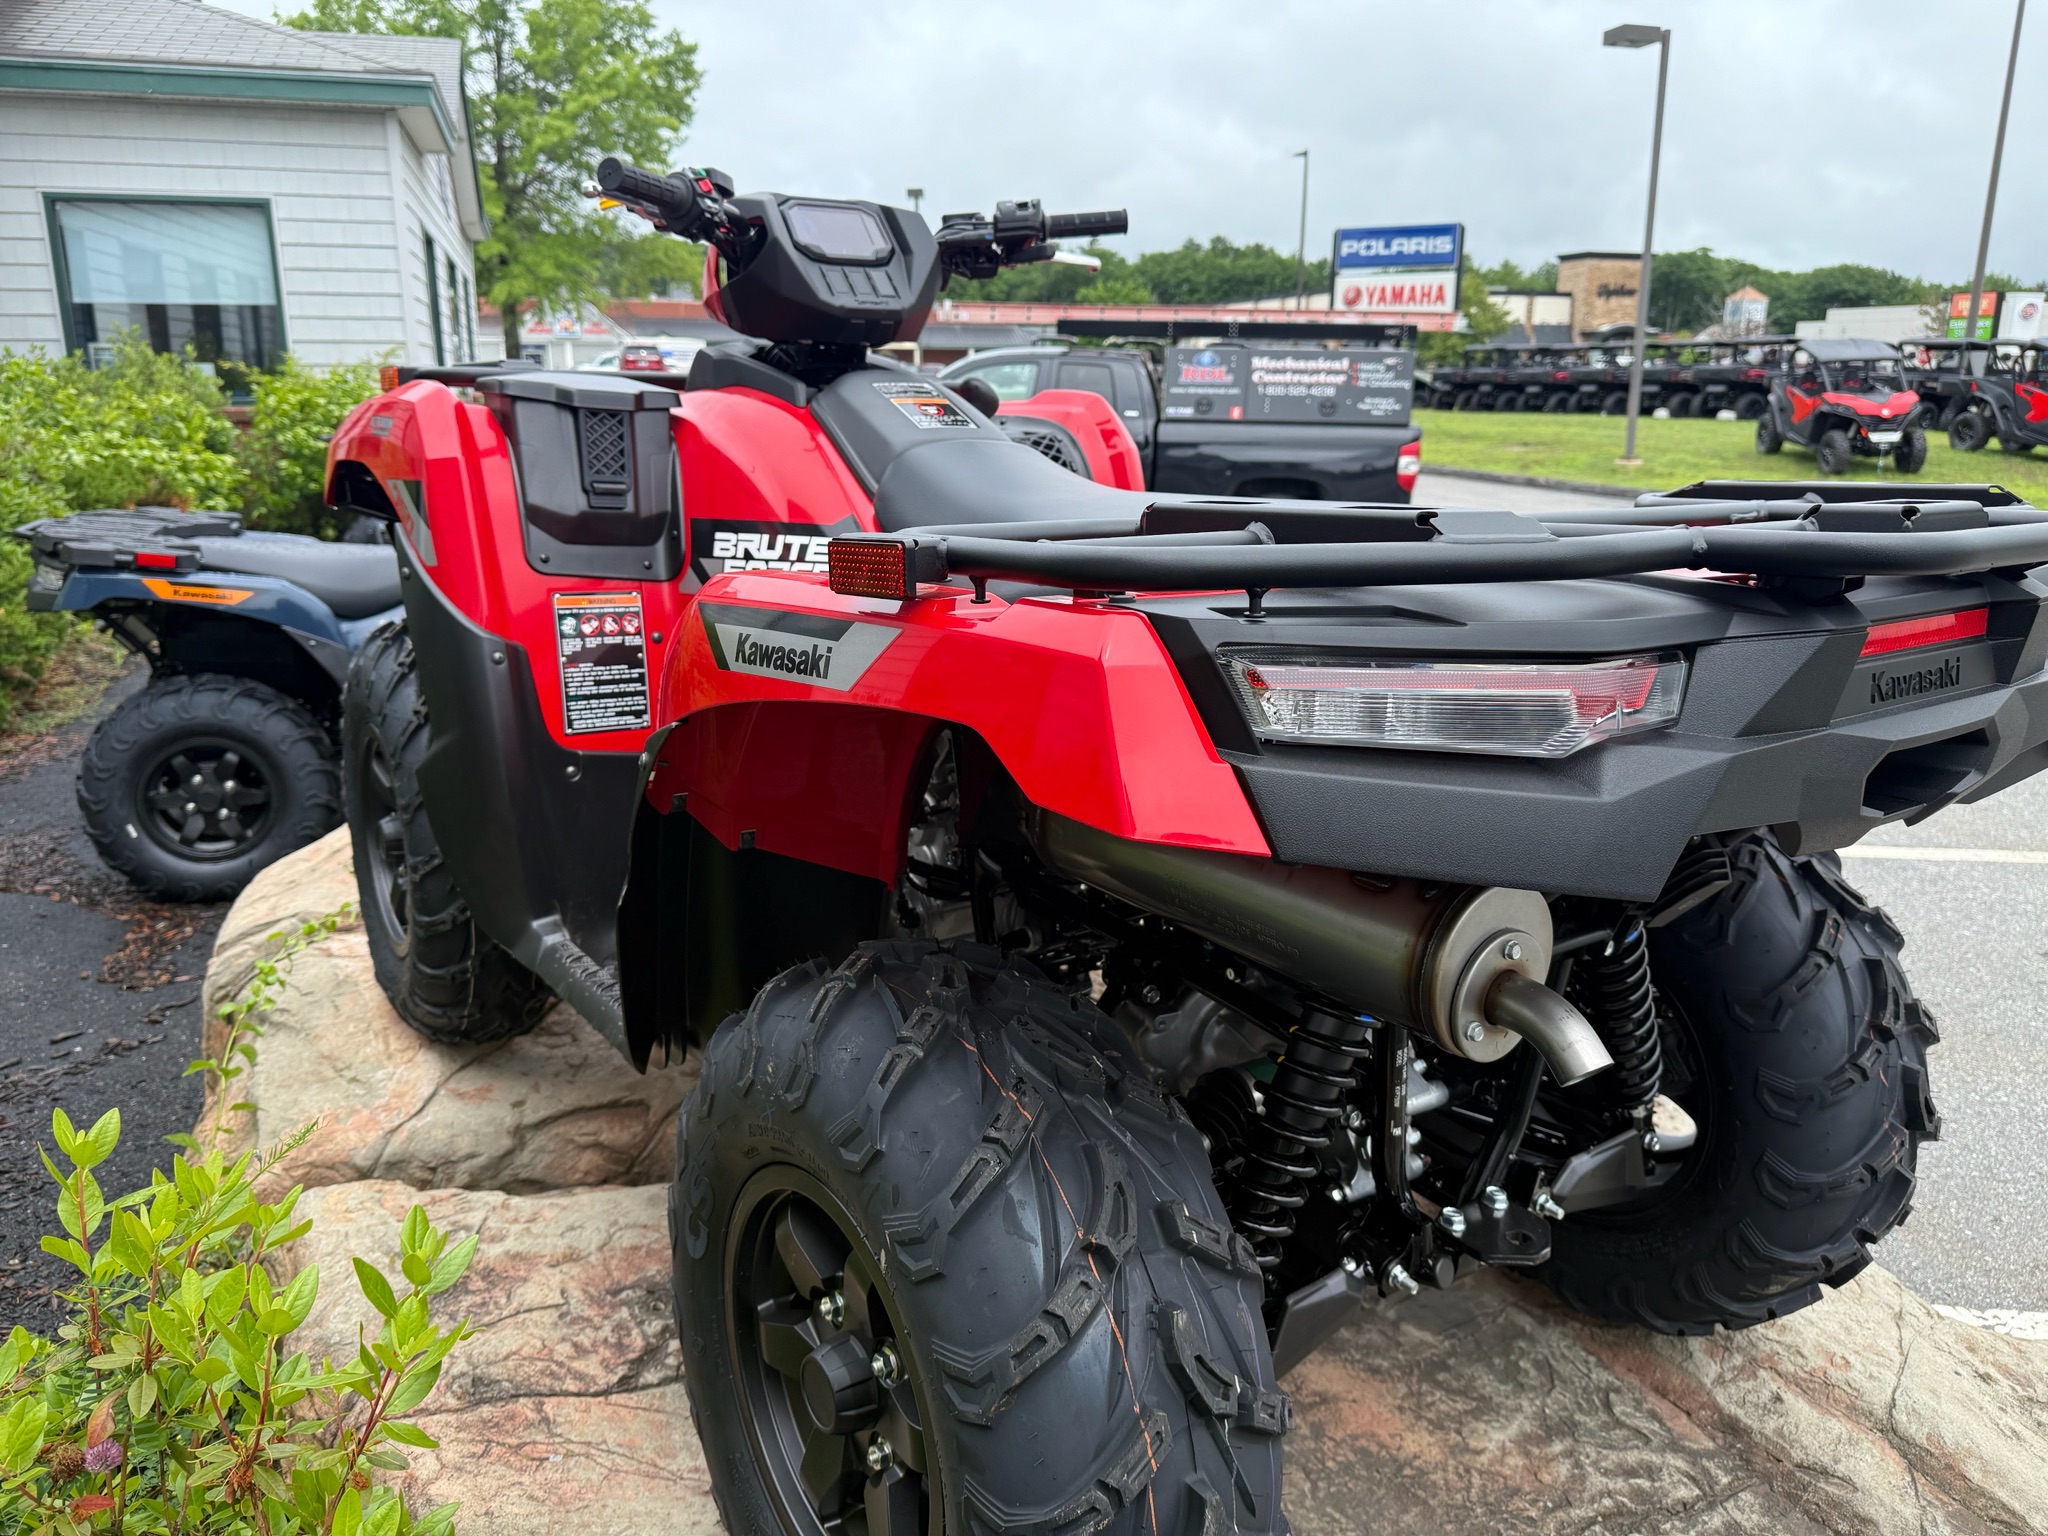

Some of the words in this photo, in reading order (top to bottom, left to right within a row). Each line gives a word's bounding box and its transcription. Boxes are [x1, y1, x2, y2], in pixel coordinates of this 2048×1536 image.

[1341, 235, 1453, 257] POLARIS
[1365, 284, 1446, 306] YAMAHA
[1251, 356, 1350, 371] Mechanical
[1251, 370, 1348, 385] Contractor
[712, 531, 832, 562] BRUTE
[173, 589, 234, 600] Kawasaki
[735, 632, 833, 680] Kawasaki
[1870, 656, 1961, 704] Kawasaki
